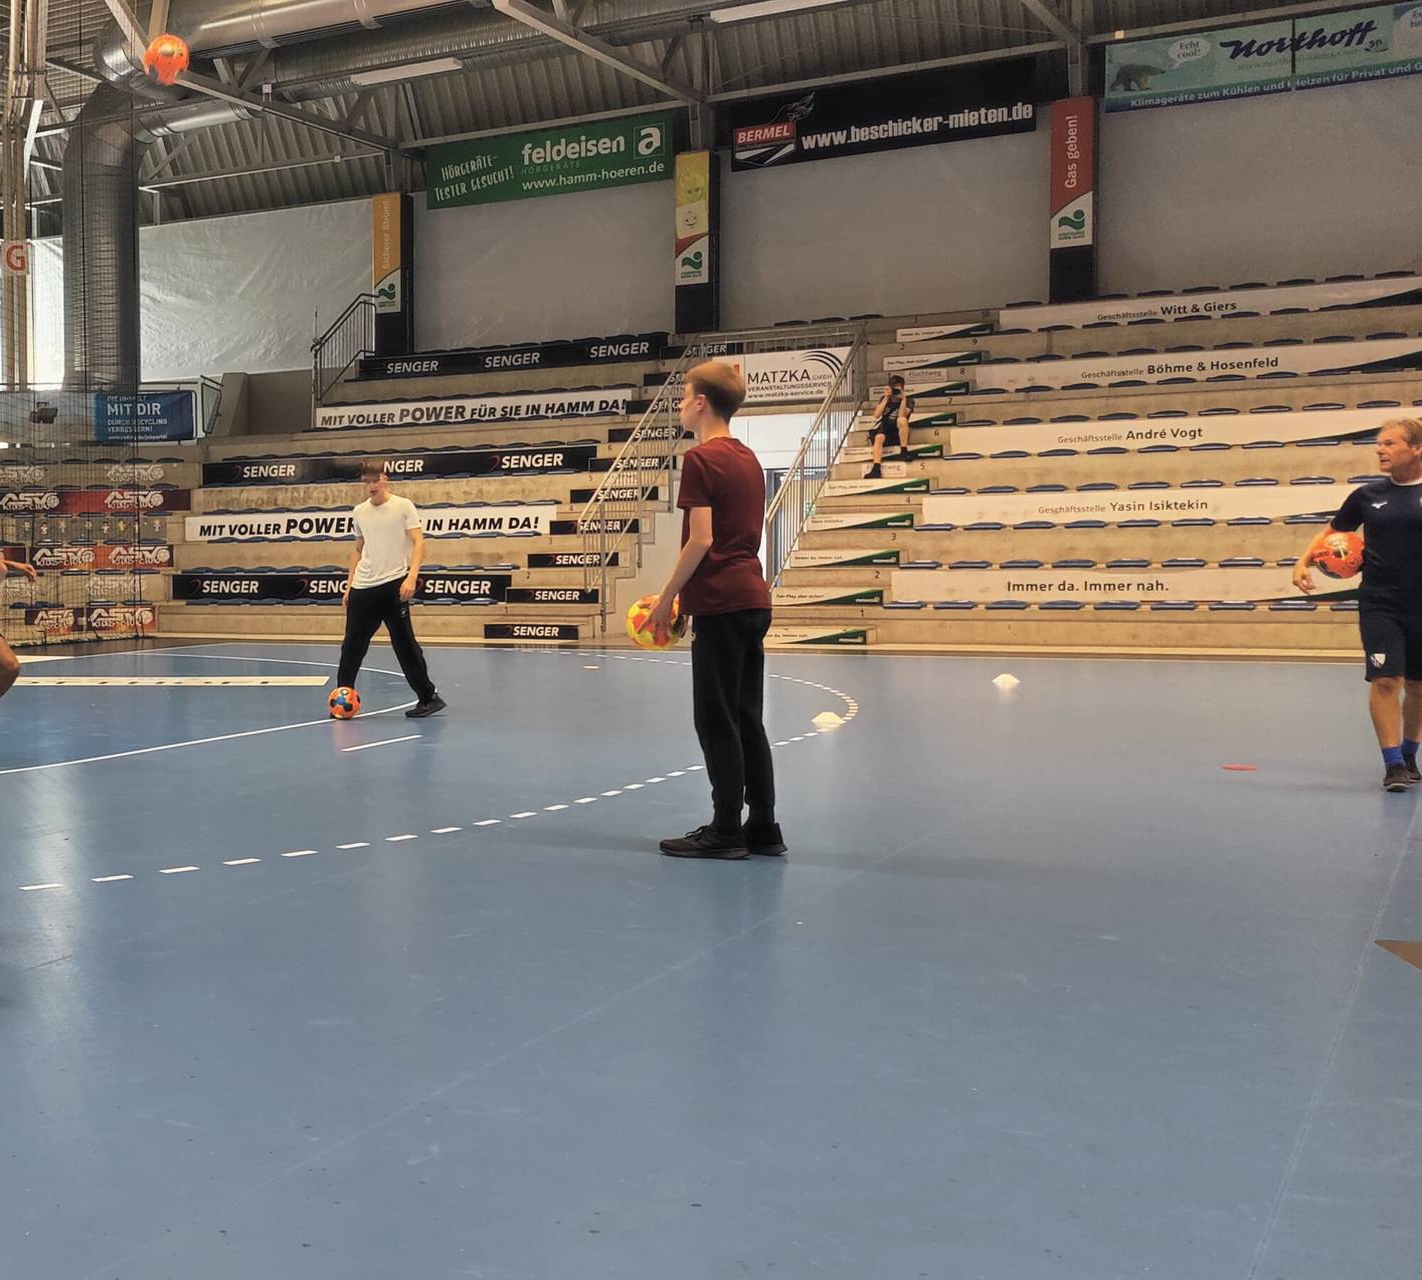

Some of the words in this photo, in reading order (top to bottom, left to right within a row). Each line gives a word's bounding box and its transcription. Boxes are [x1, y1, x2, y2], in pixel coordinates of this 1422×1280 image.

[1219, 20, 1378, 60] Northoff
[1129, 90, 1196, 108] Klimageräte
[1196, 89, 1220, 100] zum
[1222, 82, 1261, 96] Kühlen
[1262, 80, 1286, 92] und
[1331, 71, 1349, 84] für
[1351, 67, 1386, 81] Privat
[1388, 63, 1413, 76] und
[737, 124, 791, 144] BERMEL
[801, 102, 1033, 151] www.beschicker-mieten.de
[1065, 114, 1080, 161] geben!
[521, 134, 626, 166] feldeisen
[434, 183, 468, 202] TESTER
[471, 165, 515, 193] GESUCHT!
[521, 161, 665, 191] www.hamm-hoeren.de
[1064, 162, 1078, 189] Gas
[5, 244, 27, 272] G
[1097, 309, 1160, 321] Geschäftsstelle
[1160, 304, 1188, 316] Witt
[1190, 303, 1200, 313] &
[1203, 301, 1238, 313] Giers
[590, 341, 650, 359] SENGER
[386, 359, 439, 375] SENGER
[484, 351, 540, 369] SENGER
[1081, 367, 1144, 380] Geschäftsstelle
[1147, 361, 1193, 375] Böhme
[1197, 361, 1206, 372] &
[1210, 357, 1279, 371] Hosenfeld
[746, 369, 811, 386] MATZKA
[746, 381, 833, 393] VERANSTALTUNGSSERVICE
[107, 403, 133, 416] MIT
[137, 403, 162, 416] DIR
[320, 415, 345, 427] MIT
[347, 412, 396, 425] VOLLER
[398, 405, 467, 422] POWER
[470, 405, 497, 419] FÜR
[500, 404, 522, 417] SIE
[526, 403, 541, 416] IN
[544, 400, 595, 415] HAMM
[598, 398, 627, 412] DA!
[1057, 433, 1123, 444] Geschäftsstelle
[1125, 428, 1168, 441] André
[1170, 427, 1204, 440] Vogt
[383, 459, 424, 474] NGER
[501, 453, 564, 470] SENGER
[242, 464, 296, 479] SENGER
[1038, 504, 1106, 515] Geschäftsstelle
[1109, 501, 1146, 512] Yasin
[1149, 499, 1209, 511] Isiktekin
[199, 524, 227, 537] MIT
[228, 523, 282, 536] VOLLER
[426, 519, 444, 531] IN
[447, 517, 504, 531] HAMM
[508, 516, 540, 530] DA!
[555, 554, 601, 566] SENGER
[202, 579, 260, 594] SENGER
[308, 579, 349, 594] SENG
[424, 579, 492, 595] SENGER
[1006, 580, 1054, 592] Immer
[1057, 580, 1080, 592] da.
[1083, 580, 1132, 592] Immer
[1136, 579, 1170, 592] nah.
[534, 590, 580, 601] SENGER
[512, 626, 560, 637] SENGER
